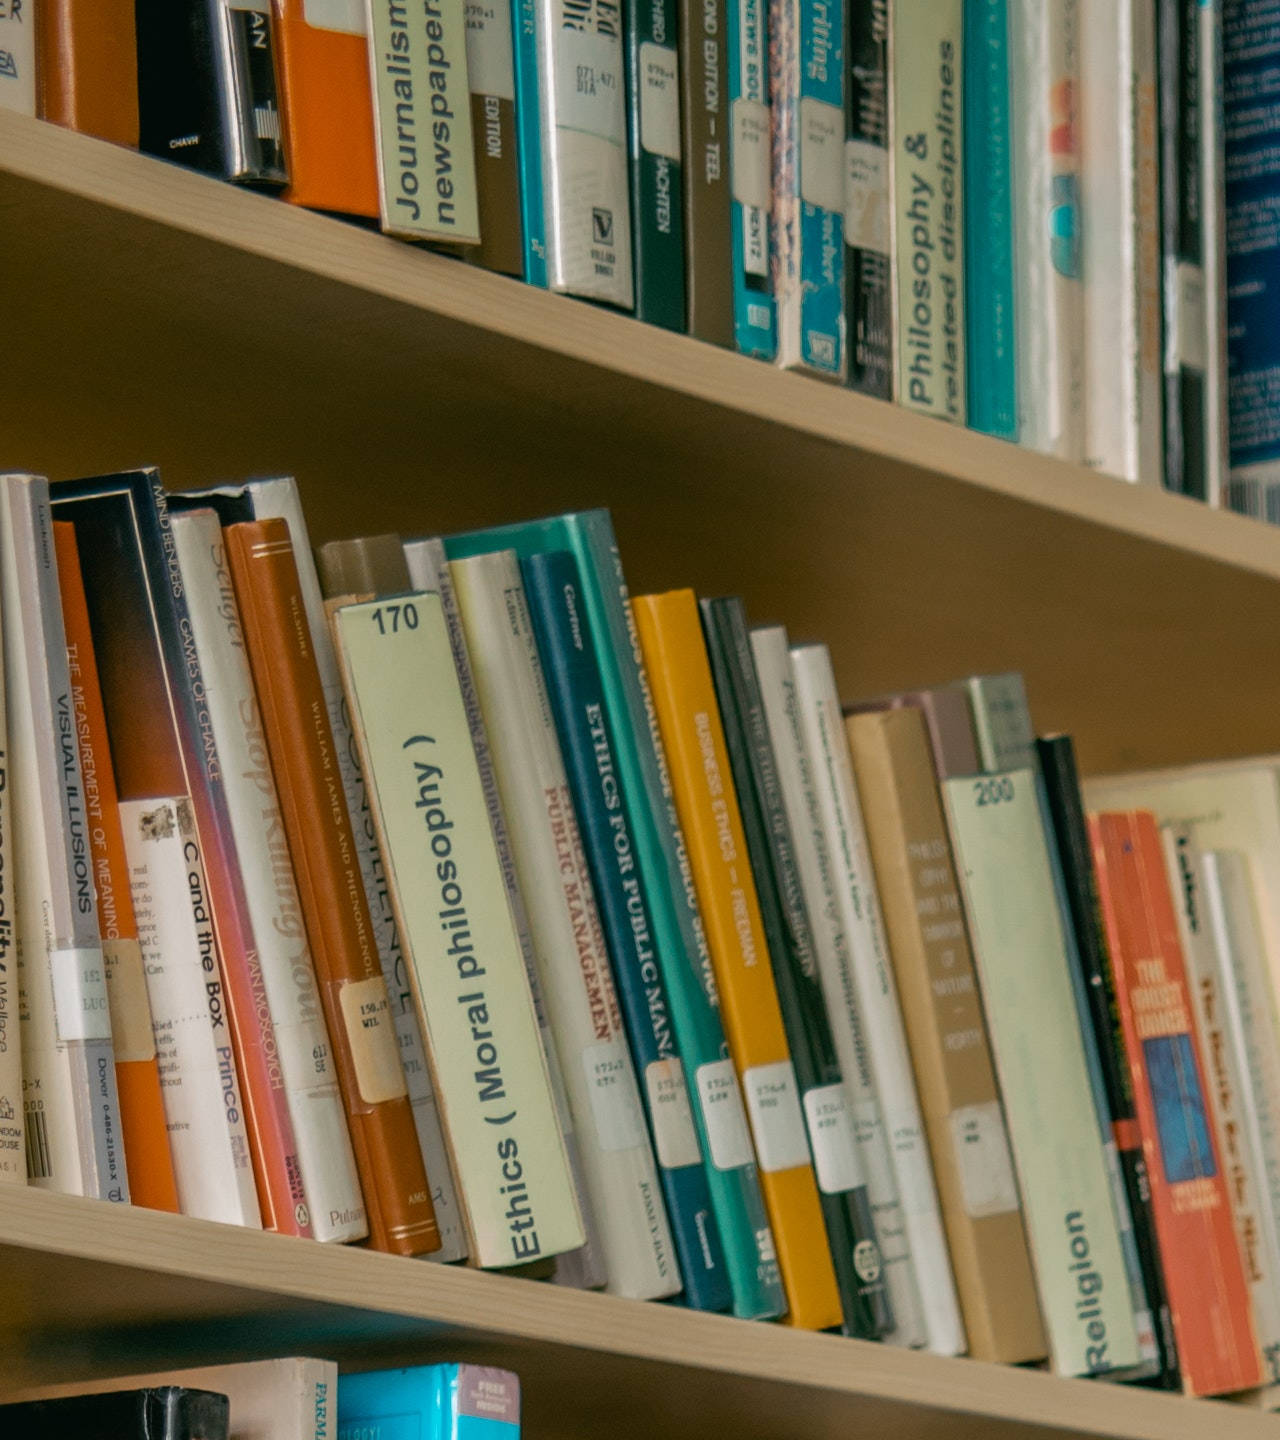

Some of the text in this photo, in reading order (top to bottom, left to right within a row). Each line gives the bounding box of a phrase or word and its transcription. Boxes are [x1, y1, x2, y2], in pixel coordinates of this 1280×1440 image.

[904, 132, 934, 405] Philosophy &
[936, 40, 957, 415] related disciplines
[371, 603, 420, 635] 170
[56, 694, 92, 915] VISUAL ILLUSIONS
[973, 777, 1015, 807] 200
[188, 871, 208, 918] and
[414, 760, 485, 982] philosophy
[198, 925, 215, 975] the
[205, 982, 223, 1030] Box
[460, 993, 506, 1103] Moral
[217, 1047, 240, 1123] Prince
[495, 1135, 539, 1261] Ethics
[1064, 1208, 1109, 1371] Religion
